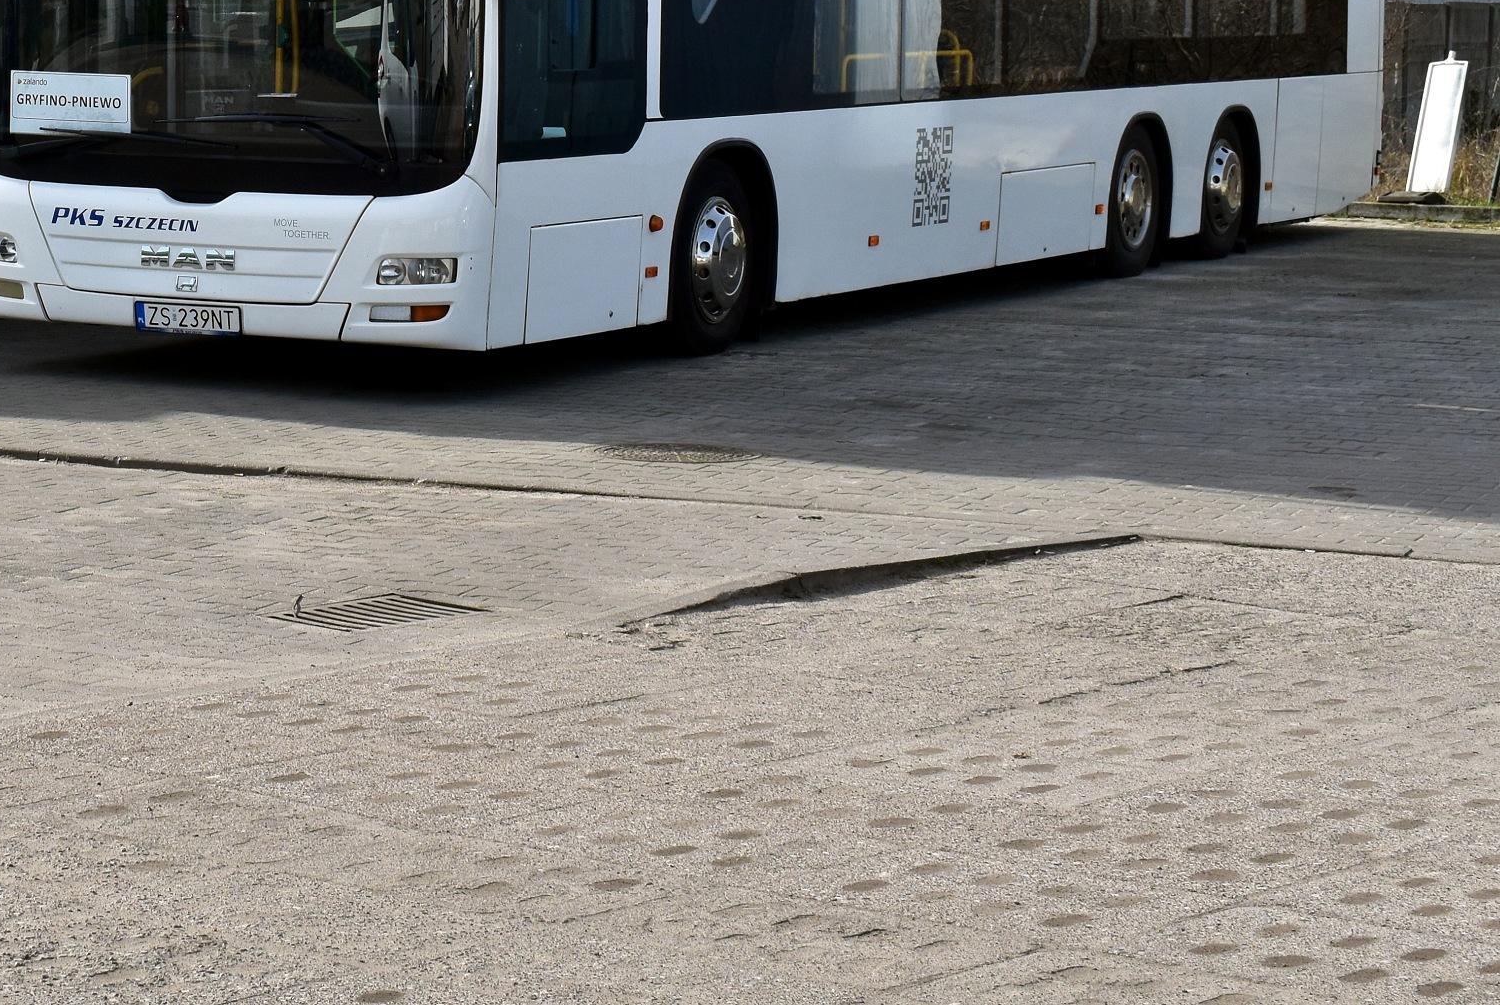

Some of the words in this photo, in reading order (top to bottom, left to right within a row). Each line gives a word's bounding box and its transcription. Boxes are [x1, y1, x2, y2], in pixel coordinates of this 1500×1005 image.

[23, 77, 48, 86] zalando
[16, 93, 122, 109] GRYFINO-PNIEWO
[51, 206, 105, 227] PKS
[112, 215, 199, 232] SZCZECIN
[273, 218, 300, 228] MOVE.
[283, 229, 331, 240] TOGETHER.
[140, 245, 236, 270] MAN
[148, 306, 171, 326] ZS
[178, 308, 233, 330] 239NT
